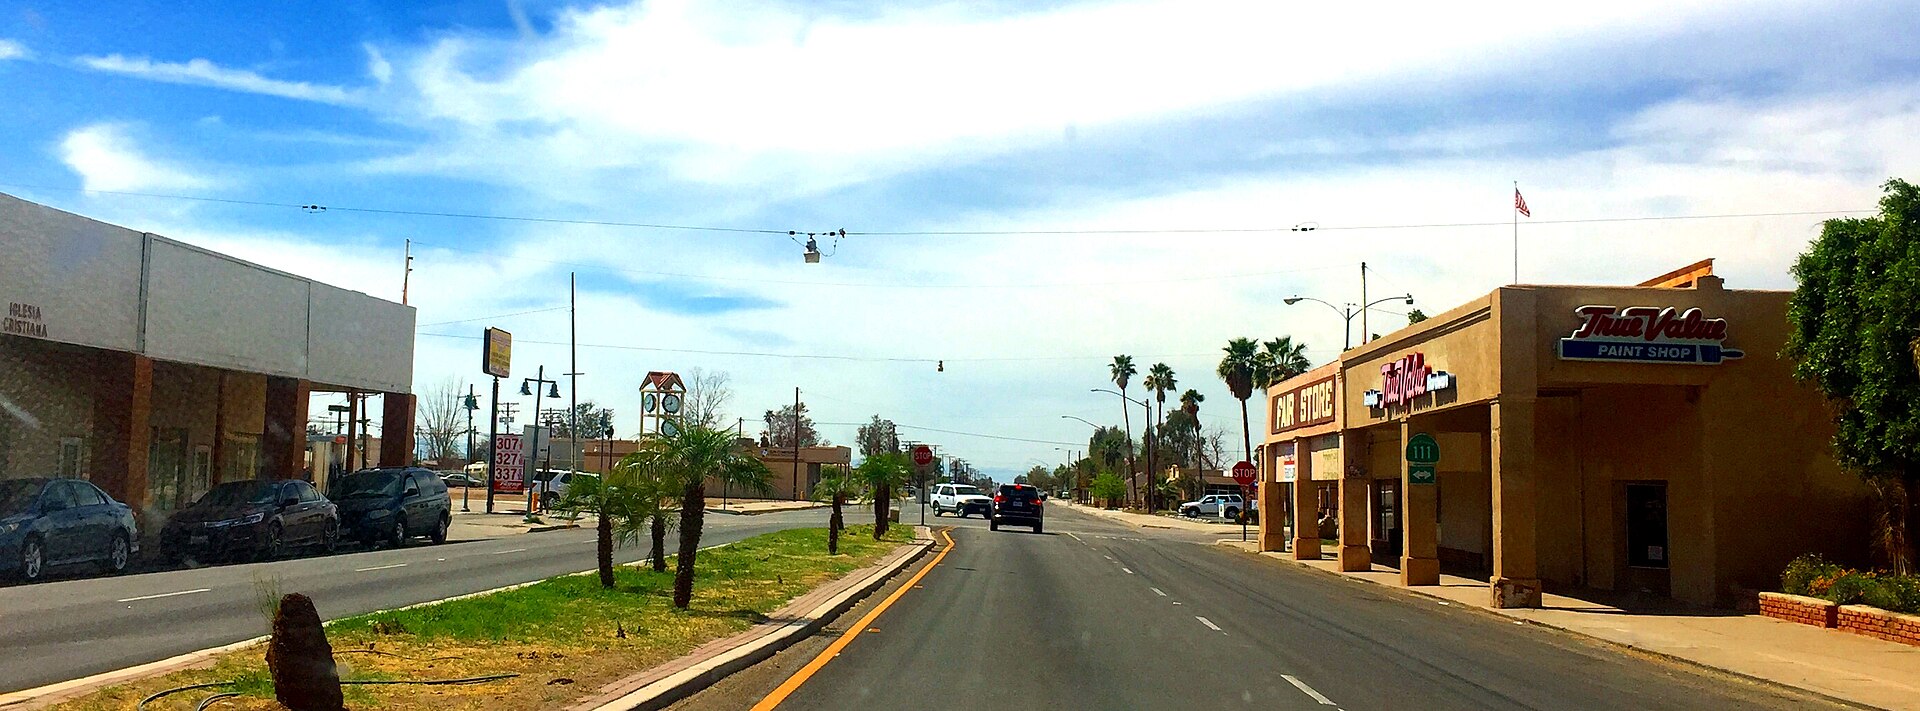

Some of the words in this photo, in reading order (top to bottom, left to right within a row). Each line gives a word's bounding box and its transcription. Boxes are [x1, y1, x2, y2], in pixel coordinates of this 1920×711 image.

[9, 302, 42, 321] IGLESIA
[3, 317, 48, 337] CRISTIANA
[1574, 305, 1643, 339] True
[1626, 306, 1728, 342] Value
[1597, 344, 1643, 357] PAINT
[1647, 346, 1692, 359] SHOP
[1379, 362, 1400, 409] True
[1395, 351, 1430, 406] Value
[1276, 392, 1296, 430] FAIR
[1300, 380, 1333, 424] STORE
[496, 437, 518, 450] 307
[496, 452, 518, 465] 327
[914, 450, 932, 460] STOP
[1413, 445, 1431, 459] 111
[495, 467, 517, 480] 337
[1233, 468, 1256, 478] STOP
